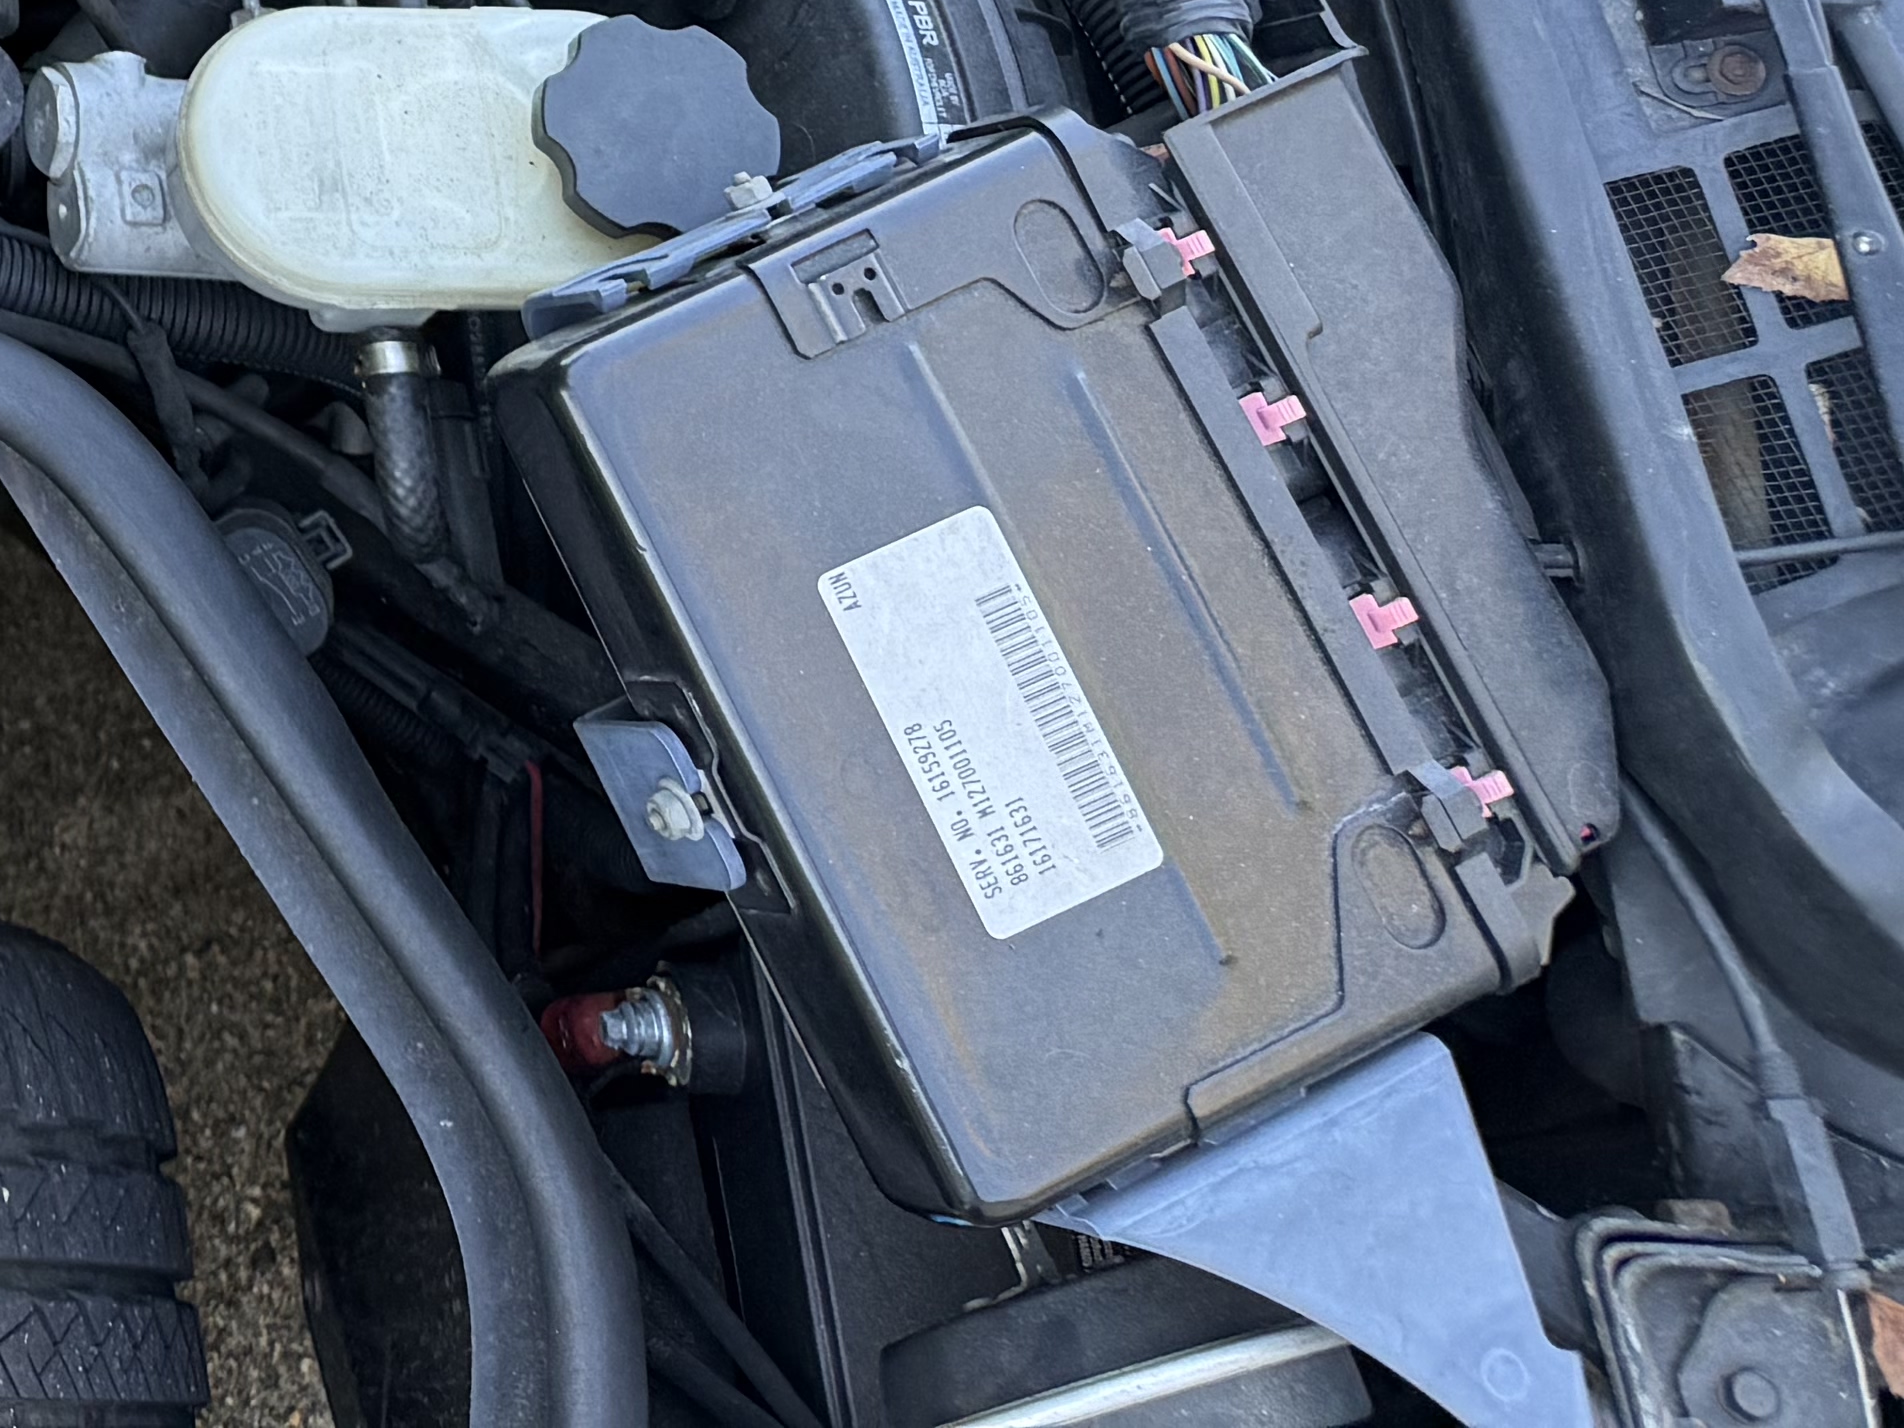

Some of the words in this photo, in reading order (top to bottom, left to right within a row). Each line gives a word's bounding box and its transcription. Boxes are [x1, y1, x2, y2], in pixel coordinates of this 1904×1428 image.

[907, 0, 939, 47] PBR
[826, 569, 863, 614] AZUN
[899, 720, 957, 803] 16159278
[930, 717, 998, 820] M127001105
[984, 824, 1030, 887] 861631
[1001, 794, 1059, 877] 16171631
